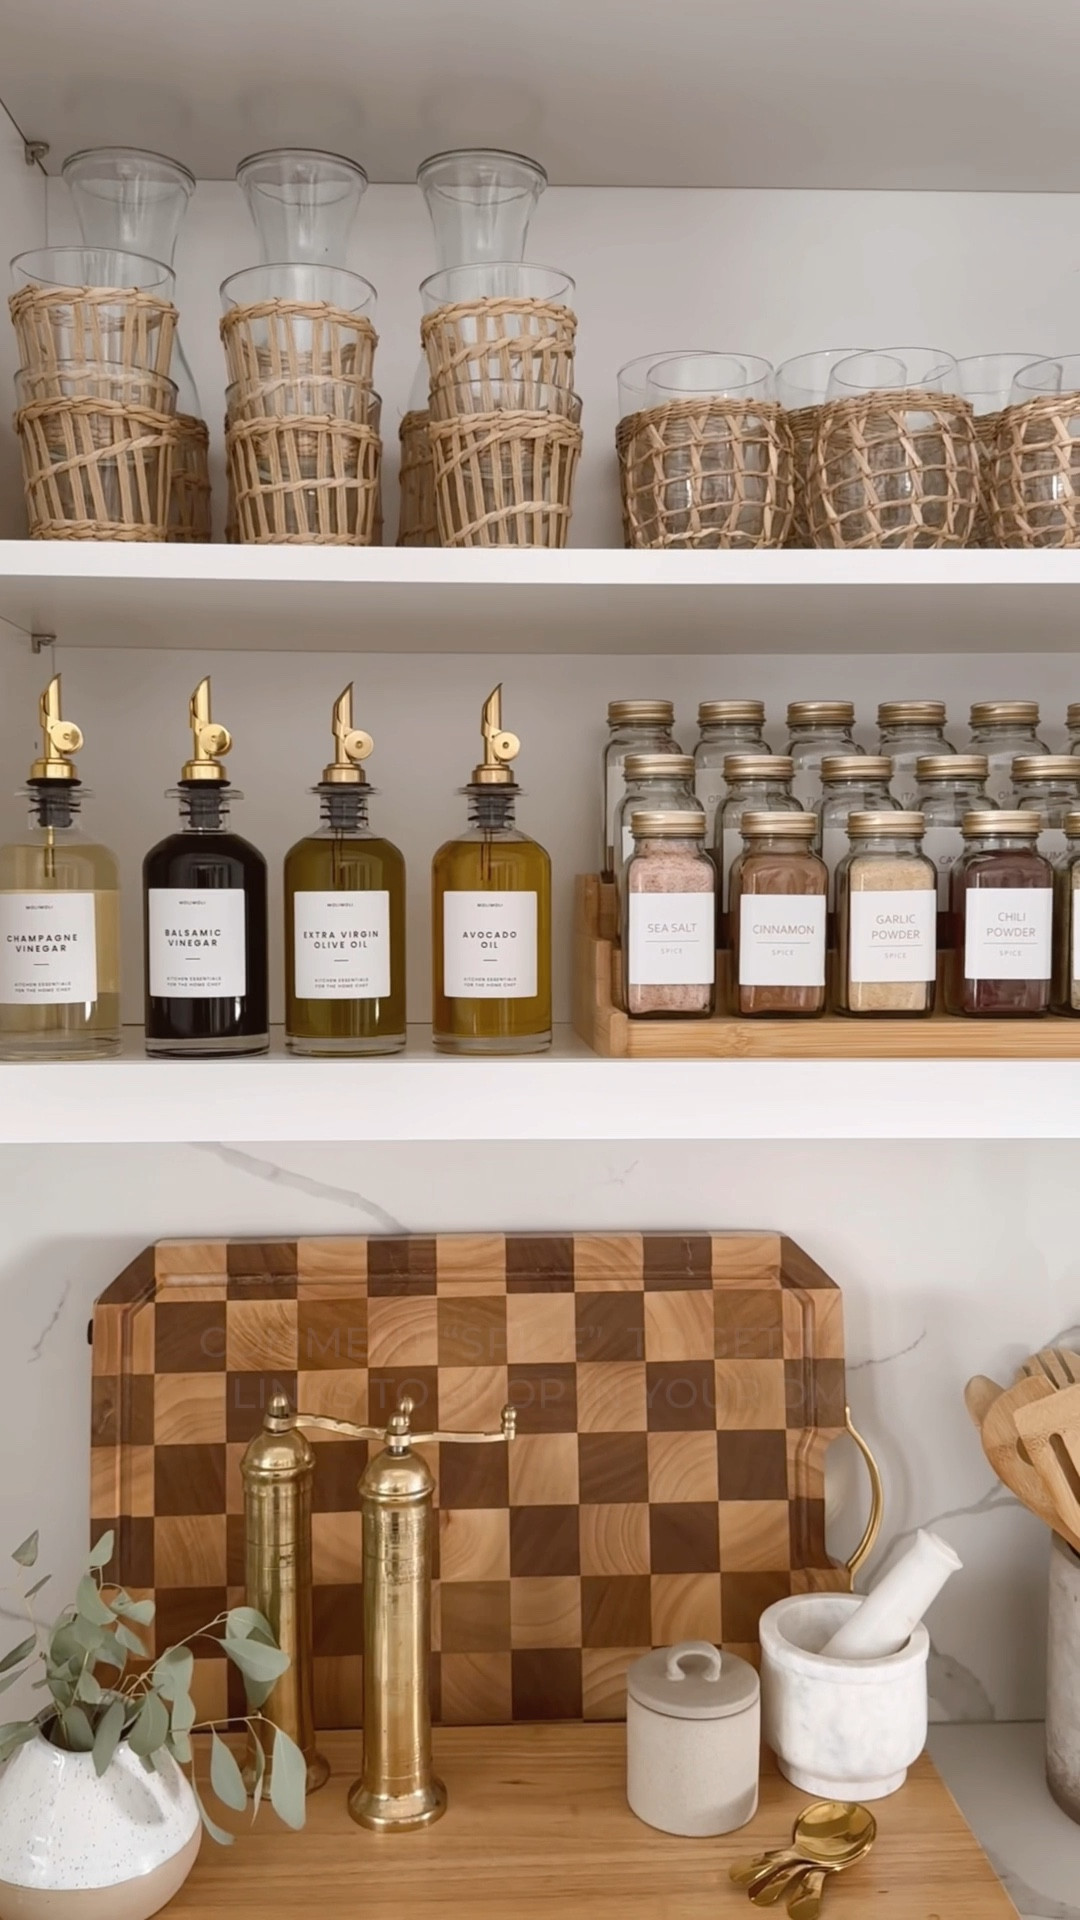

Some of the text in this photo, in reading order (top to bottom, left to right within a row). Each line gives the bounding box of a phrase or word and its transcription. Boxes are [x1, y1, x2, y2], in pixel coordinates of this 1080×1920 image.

[875, 914, 916, 925] GARLIC
[997, 912, 1027, 923] CHILI
[164, 928, 222, 937] BALSAMIC
[647, 922, 698, 934] SEA SALT
[752, 924, 815, 935] CINNAMON
[986, 927, 1037, 938] POWDER
[6, 933, 78, 943] CHAMPAGNE
[303, 930, 379, 939] EXTRA VIRGIN
[462, 930, 518, 939] AVOCADO
[871, 929, 921, 940] POWDER
[167, 938, 218, 947] VINEGAR
[313, 940, 368, 950] OLIVE OIL
[480, 941, 499, 949] OIL
[15, 944, 67, 953] VINEGAR
